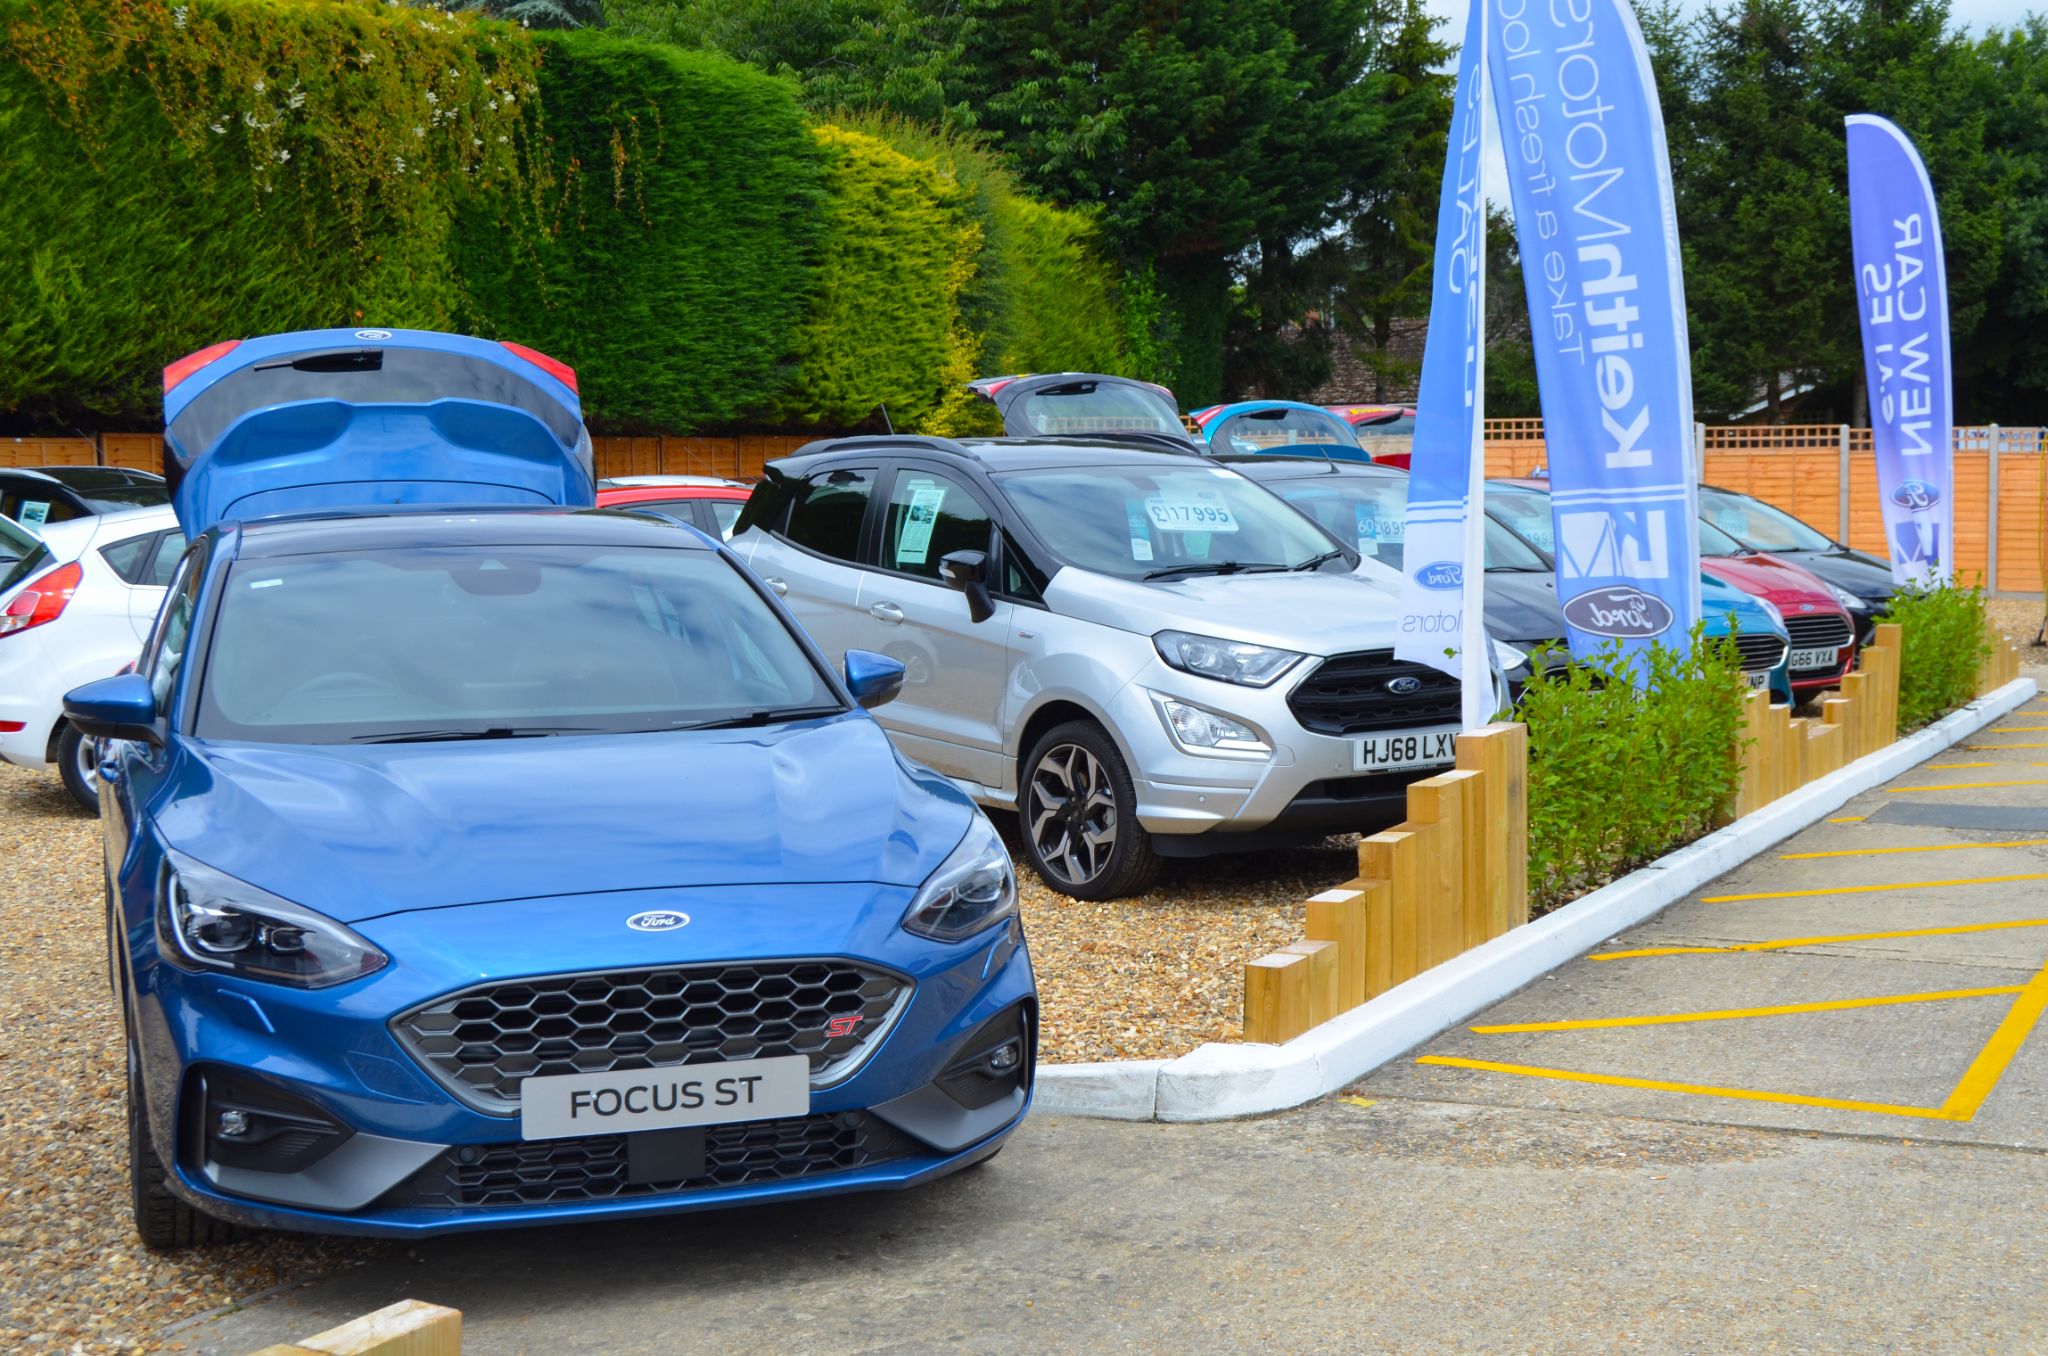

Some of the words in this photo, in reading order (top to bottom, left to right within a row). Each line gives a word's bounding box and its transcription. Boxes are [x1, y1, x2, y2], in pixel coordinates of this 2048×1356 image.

[1747, 674, 1765, 690] NP
[1363, 736, 1417, 765] HJ68
[641, 914, 676, 927] Ford
[826, 1015, 863, 1037] ST
[570, 1081, 703, 1119] FOCUS
[714, 1075, 763, 1106] ST
